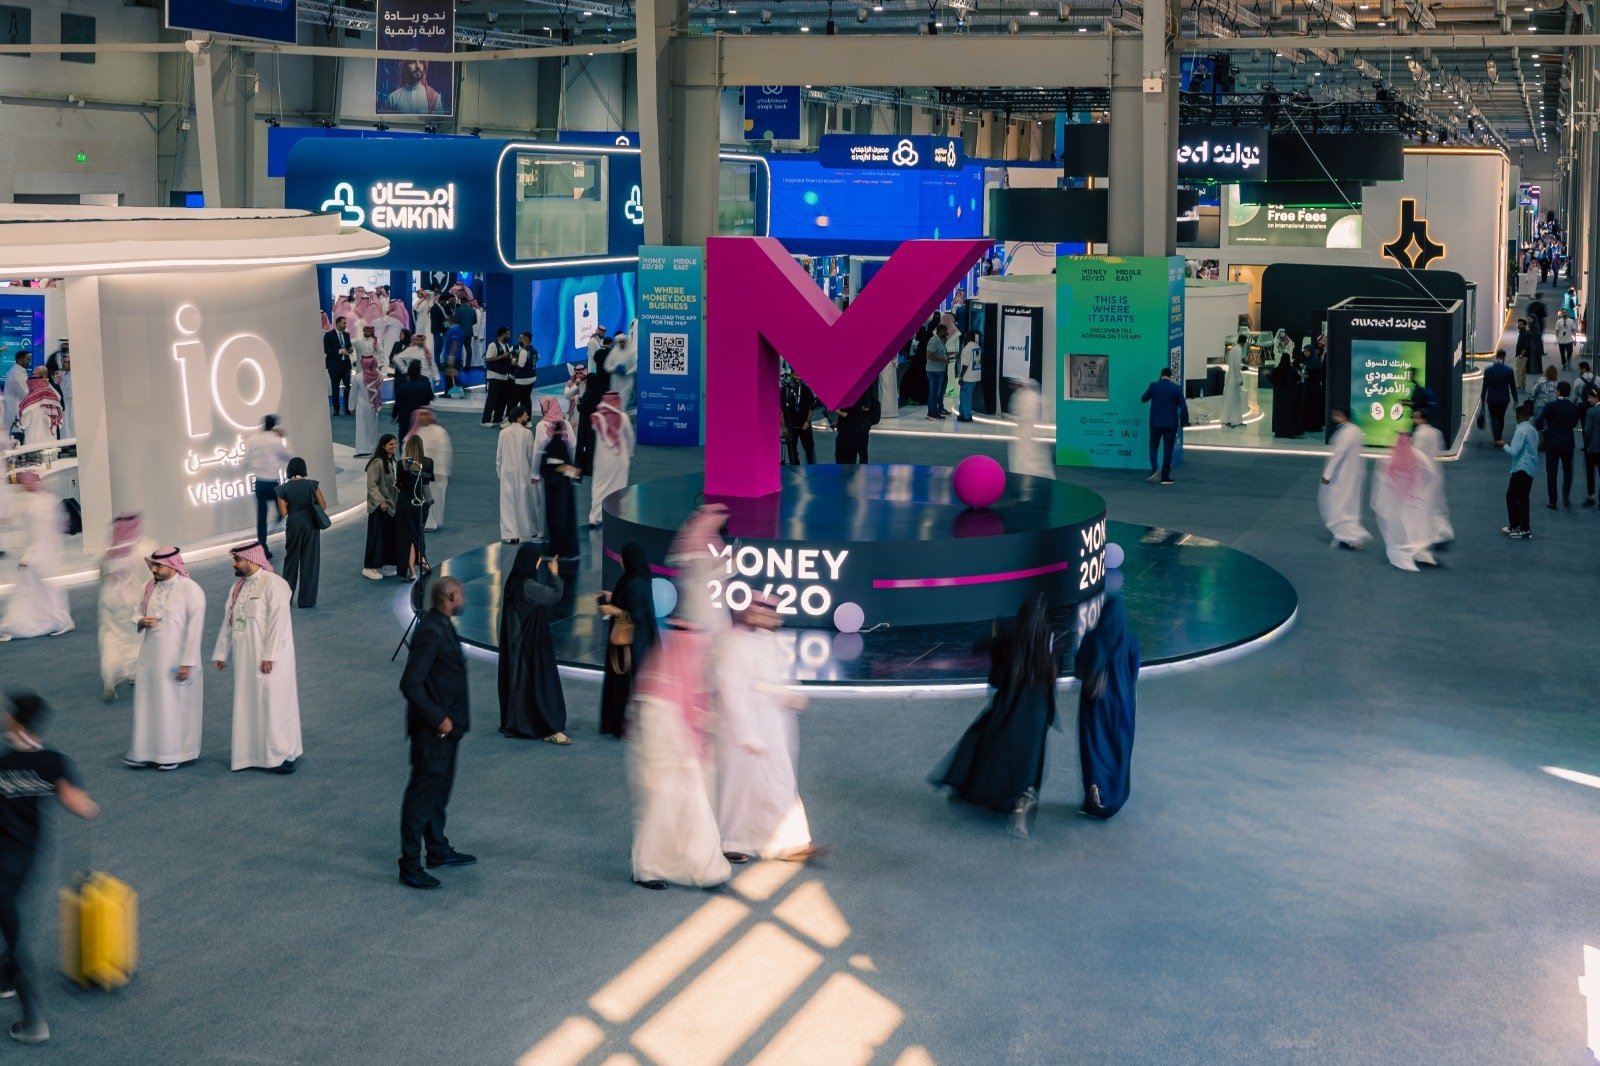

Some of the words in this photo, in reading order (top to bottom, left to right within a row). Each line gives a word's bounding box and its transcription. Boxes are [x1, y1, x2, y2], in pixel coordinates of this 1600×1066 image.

[384, 10, 420, 23] ريادة
[422, 10, 446, 23] نحو
[384, 25, 417, 38] رقمية
[418, 25, 446, 38] مالية
[851, 153, 871, 162] alrajhi
[871, 153, 889, 161] bank
[1177, 140, 1208, 163] ed
[1212, 142, 1260, 169] عوائد
[371, 182, 455, 208] إمكان
[371, 206, 455, 230] EMKAN
[1267, 209, 1295, 222] Free
[1297, 210, 1327, 222] Fees
[654, 286, 685, 294] WHERE
[642, 294, 673, 302] MONEY
[674, 295, 697, 303] DOES
[1094, 295, 1117, 304] THIS
[1119, 296, 1128, 304] IS
[648, 302, 688, 310] BUSINESS
[1092, 305, 1131, 314] WHERE
[1088, 315, 1098, 323] IT
[1098, 315, 1135, 323] STARTS
[1350, 317, 1394, 328] awaed
[1394, 317, 1427, 331] عوائد
[1365, 359, 1388, 368] للسوق
[1365, 370, 1410, 384] السعودي
[1364, 380, 1411, 398] والأمريكي
[186, 478, 246, 506] Vision
[1080, 517, 1106, 557] MON
[706, 543, 849, 580] MONEY
[1079, 549, 1106, 591] 20/2
[705, 579, 831, 616] 20/20
